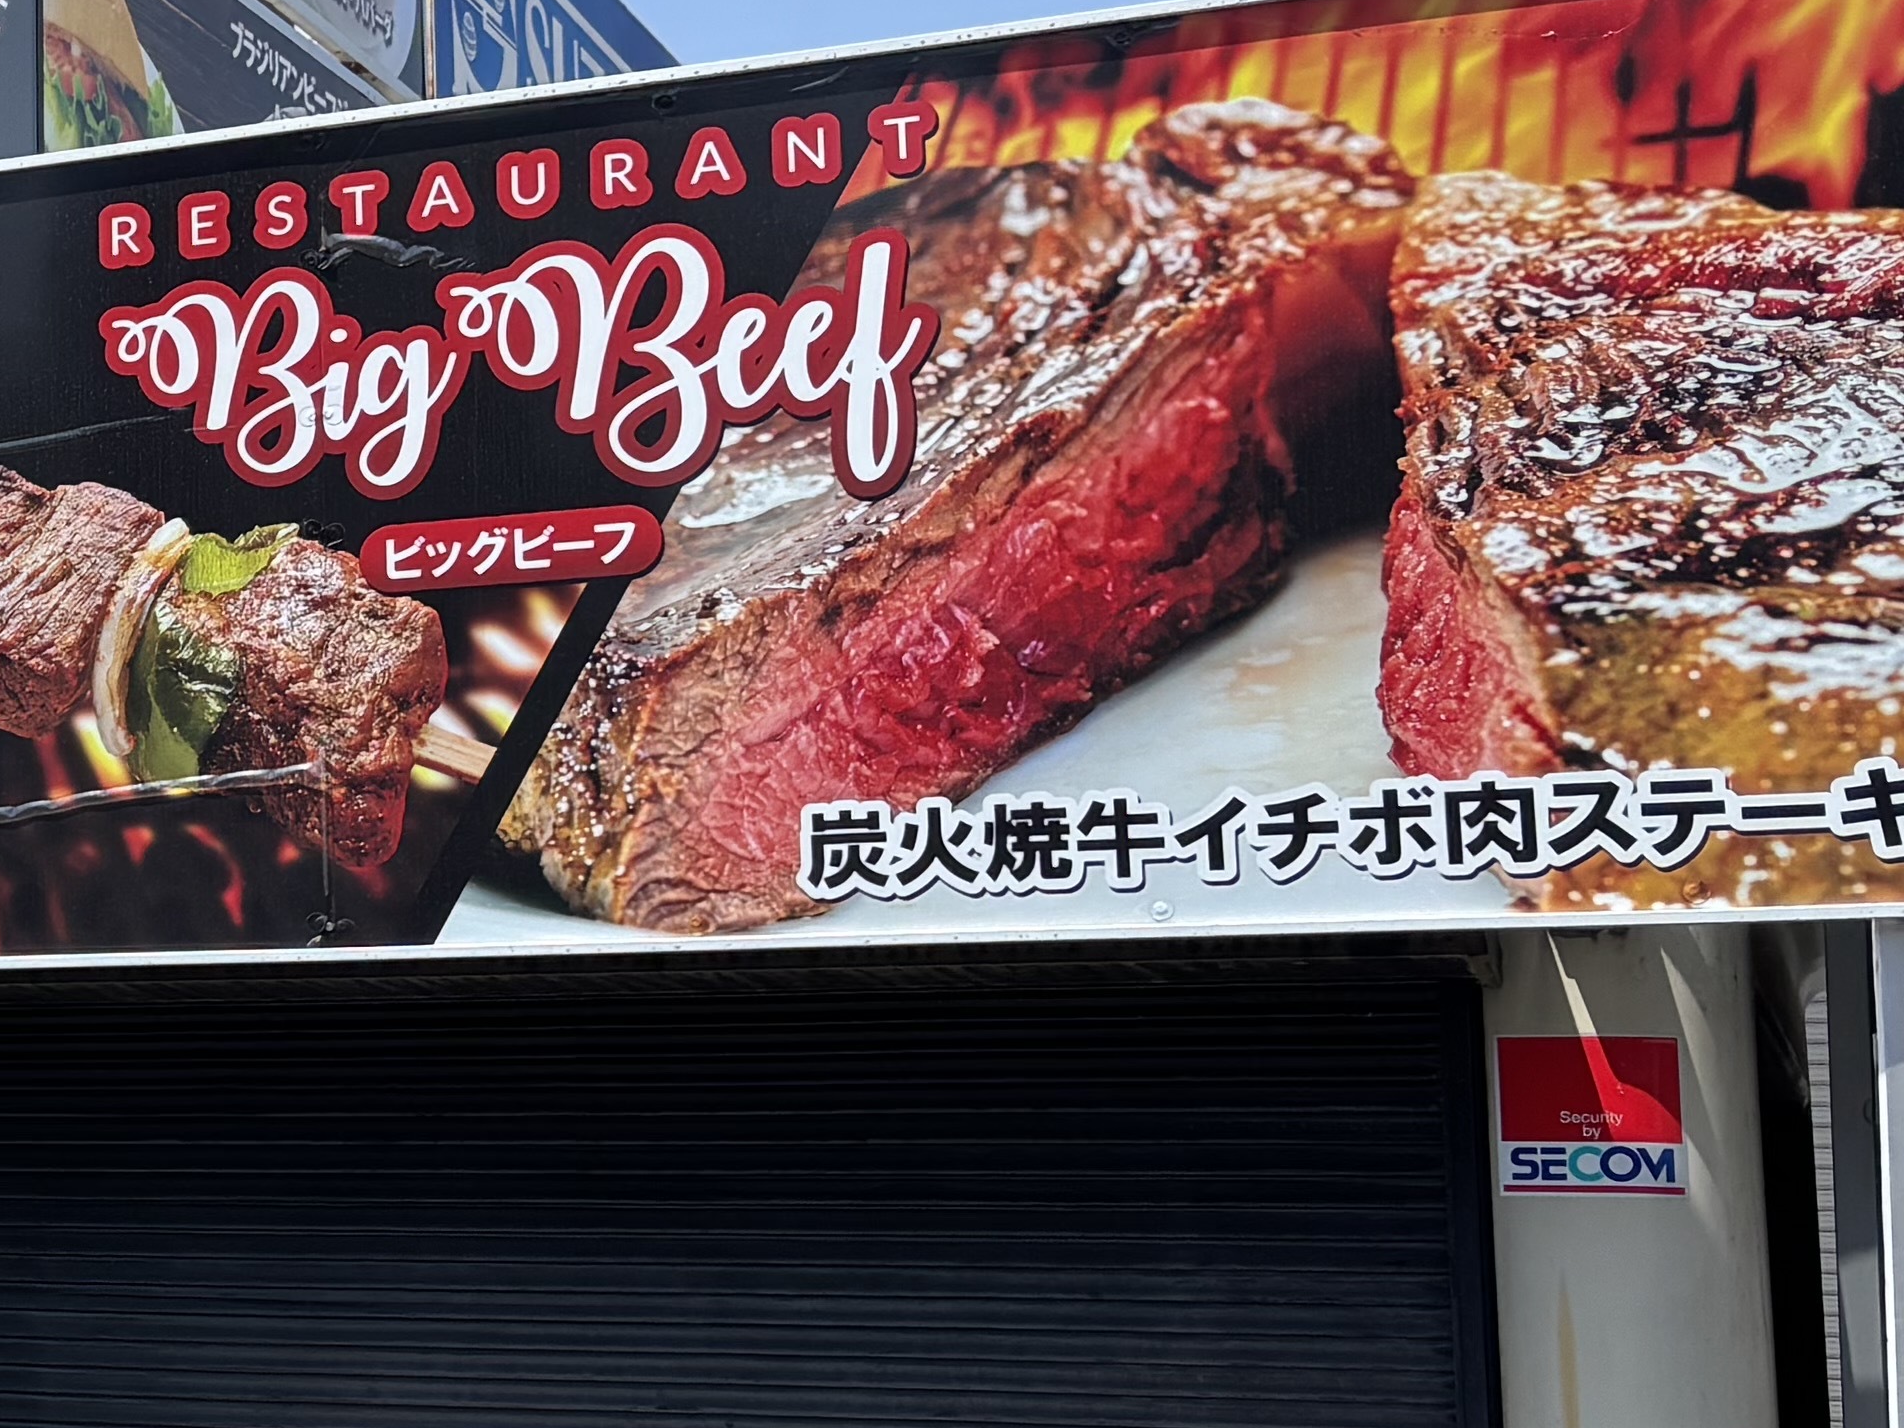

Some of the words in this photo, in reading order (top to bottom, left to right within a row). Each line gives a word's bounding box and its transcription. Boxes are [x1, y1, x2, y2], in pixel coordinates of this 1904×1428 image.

[109, 115, 923, 258] RESTAURANT
[110, 279, 457, 489] Big
[449, 236, 924, 482] Beef
[384, 519, 638, 581] ビッグビーフ
[806, 765, 1904, 889] 炭火焼牛イチボ肉ステーキ
[1559, 1110, 1624, 1127] Security
[1582, 1124, 1602, 1140] by
[1509, 1145, 1677, 1184] SECOM
